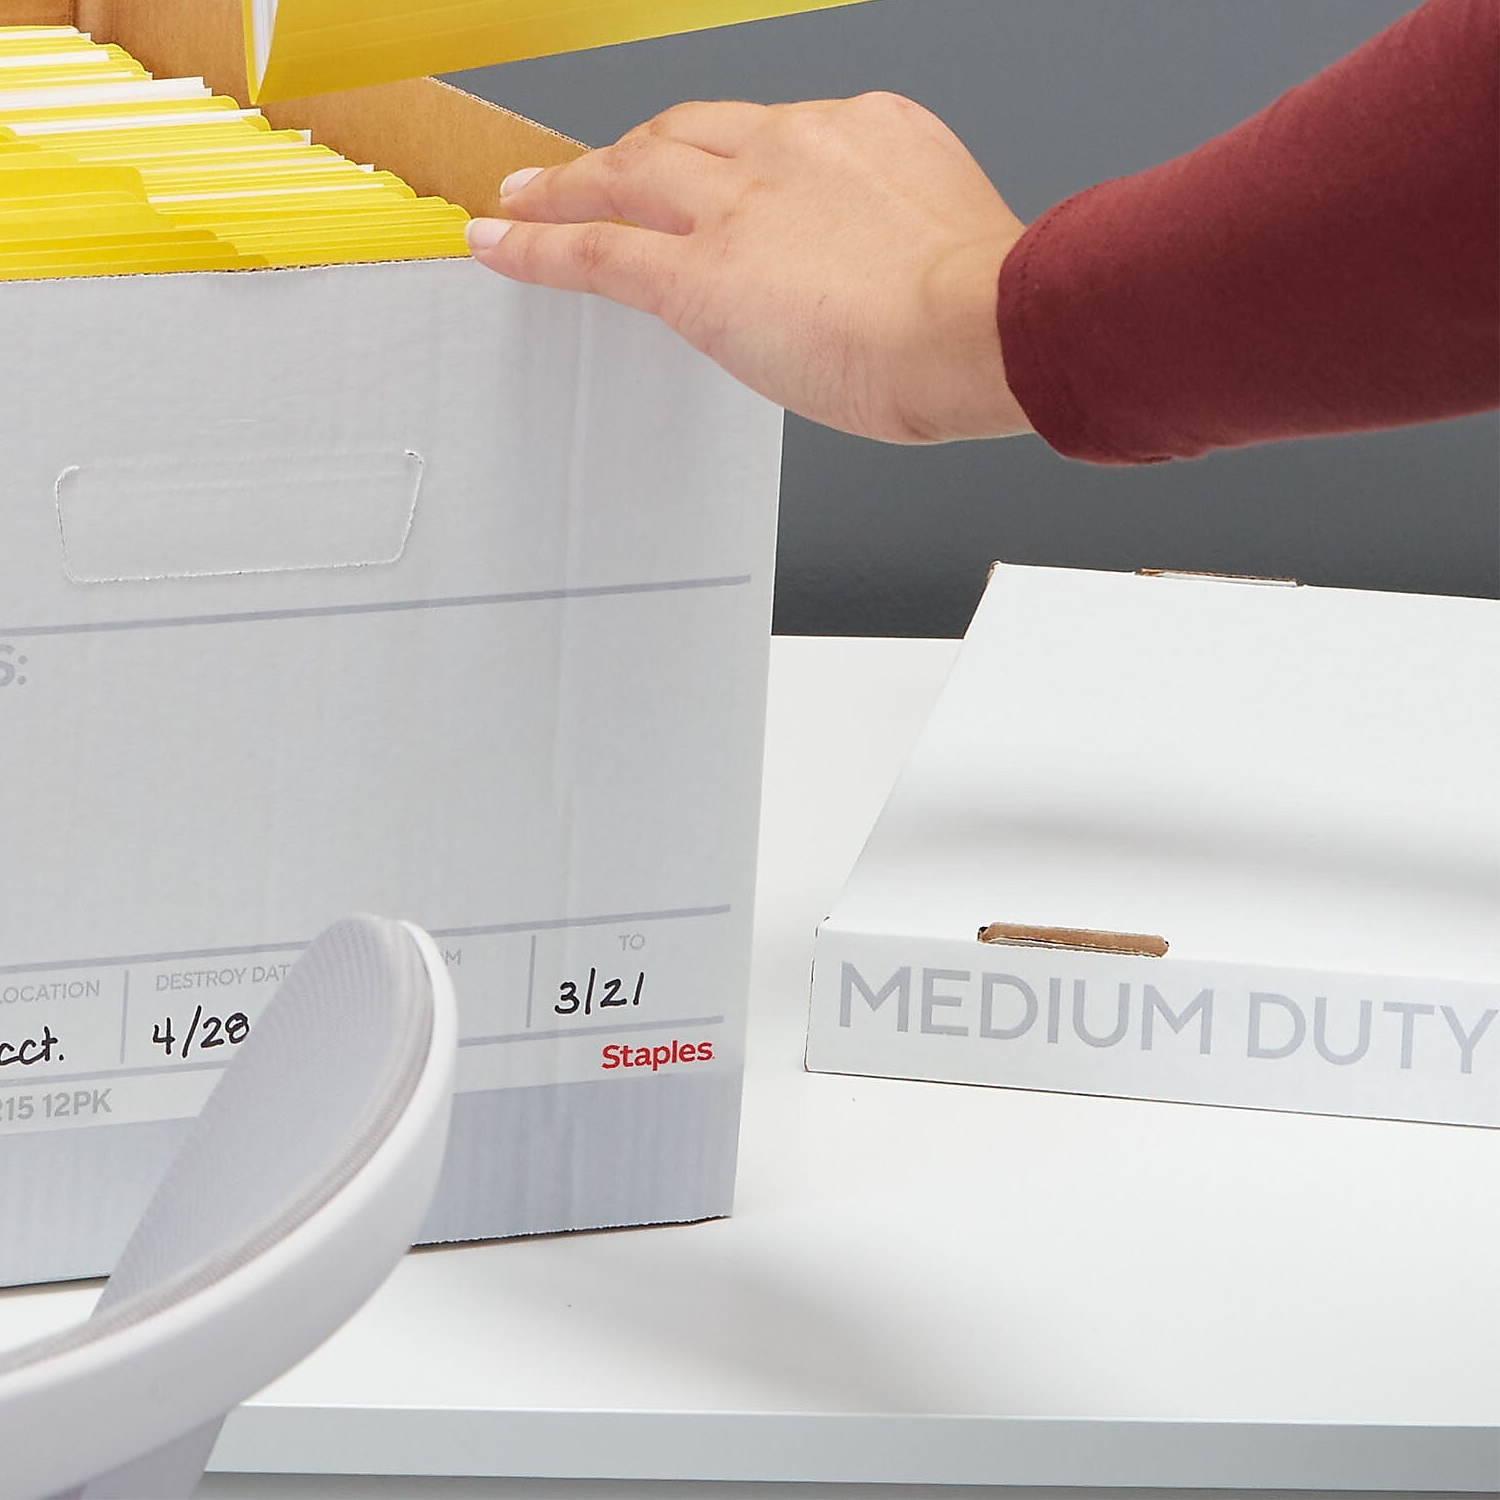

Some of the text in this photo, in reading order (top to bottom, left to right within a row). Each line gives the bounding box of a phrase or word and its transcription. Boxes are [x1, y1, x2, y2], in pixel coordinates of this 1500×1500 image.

[617, 934, 645, 950] TO
[156, 964, 291, 991] DESTROY DAT
[554, 967, 644, 1015] 3/21
[152, 1005, 250, 1058] 4/28
[838, 961, 1499, 1075] MEDIUM DUTY
[43, 1088, 112, 1118] 12PK
